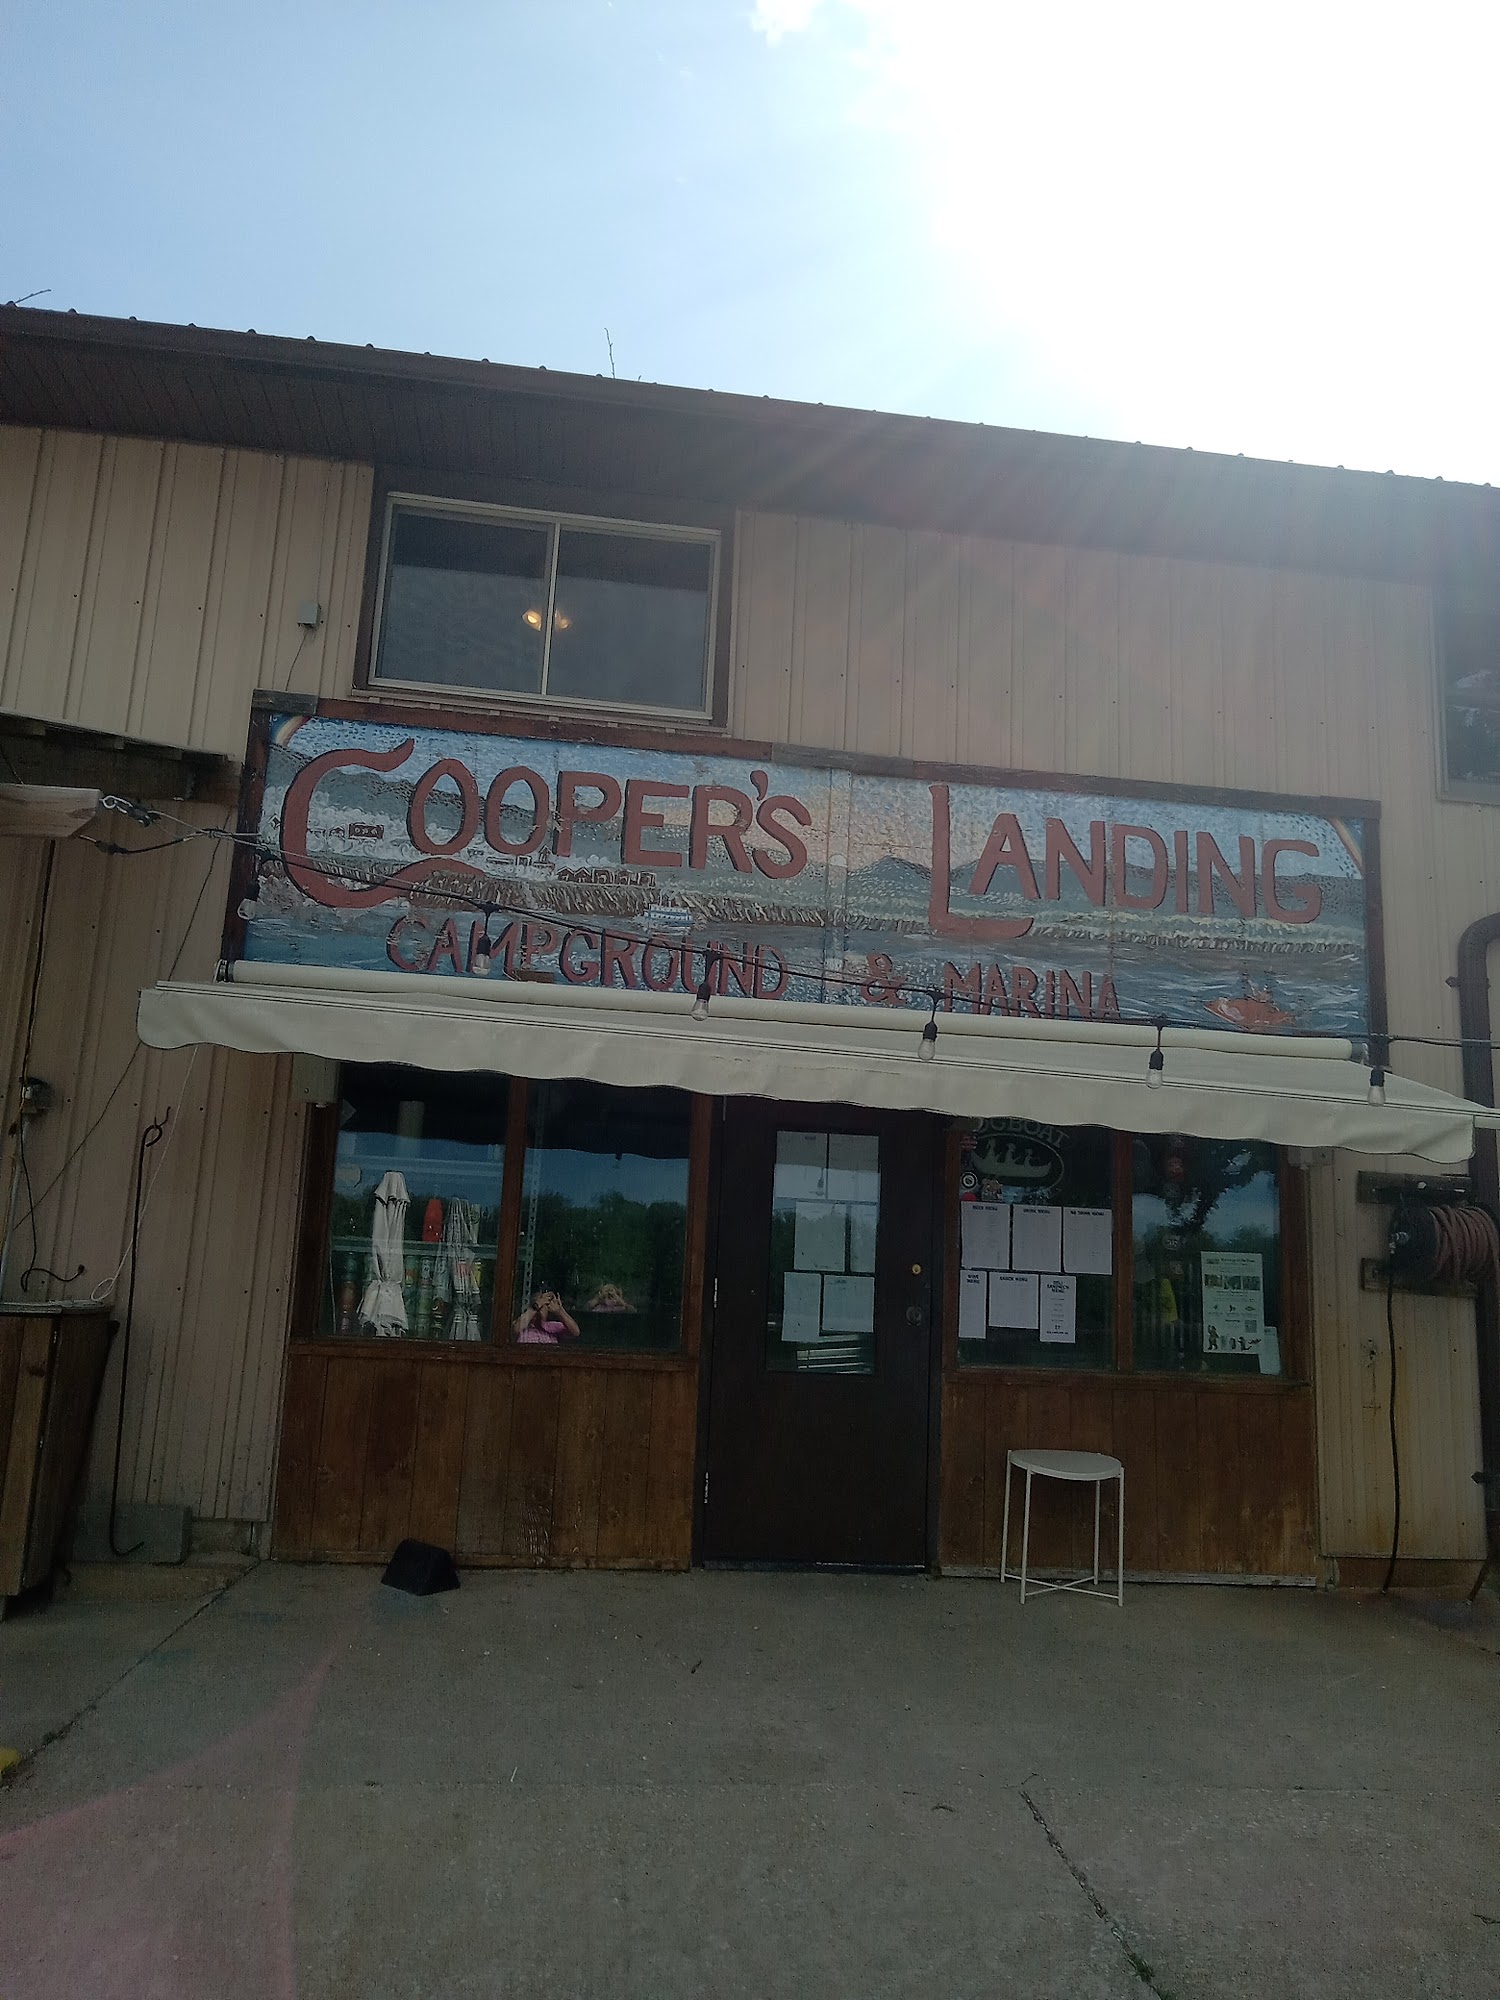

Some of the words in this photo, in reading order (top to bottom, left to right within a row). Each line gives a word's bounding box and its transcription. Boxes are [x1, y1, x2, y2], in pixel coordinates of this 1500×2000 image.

[279, 738, 813, 909] COOPER'S
[927, 783, 1322, 939] LANDING
[386, 913, 790, 1000] CAMPGROUND
[860, 952, 908, 1005] &
[943, 961, 1122, 1023] MARINA
